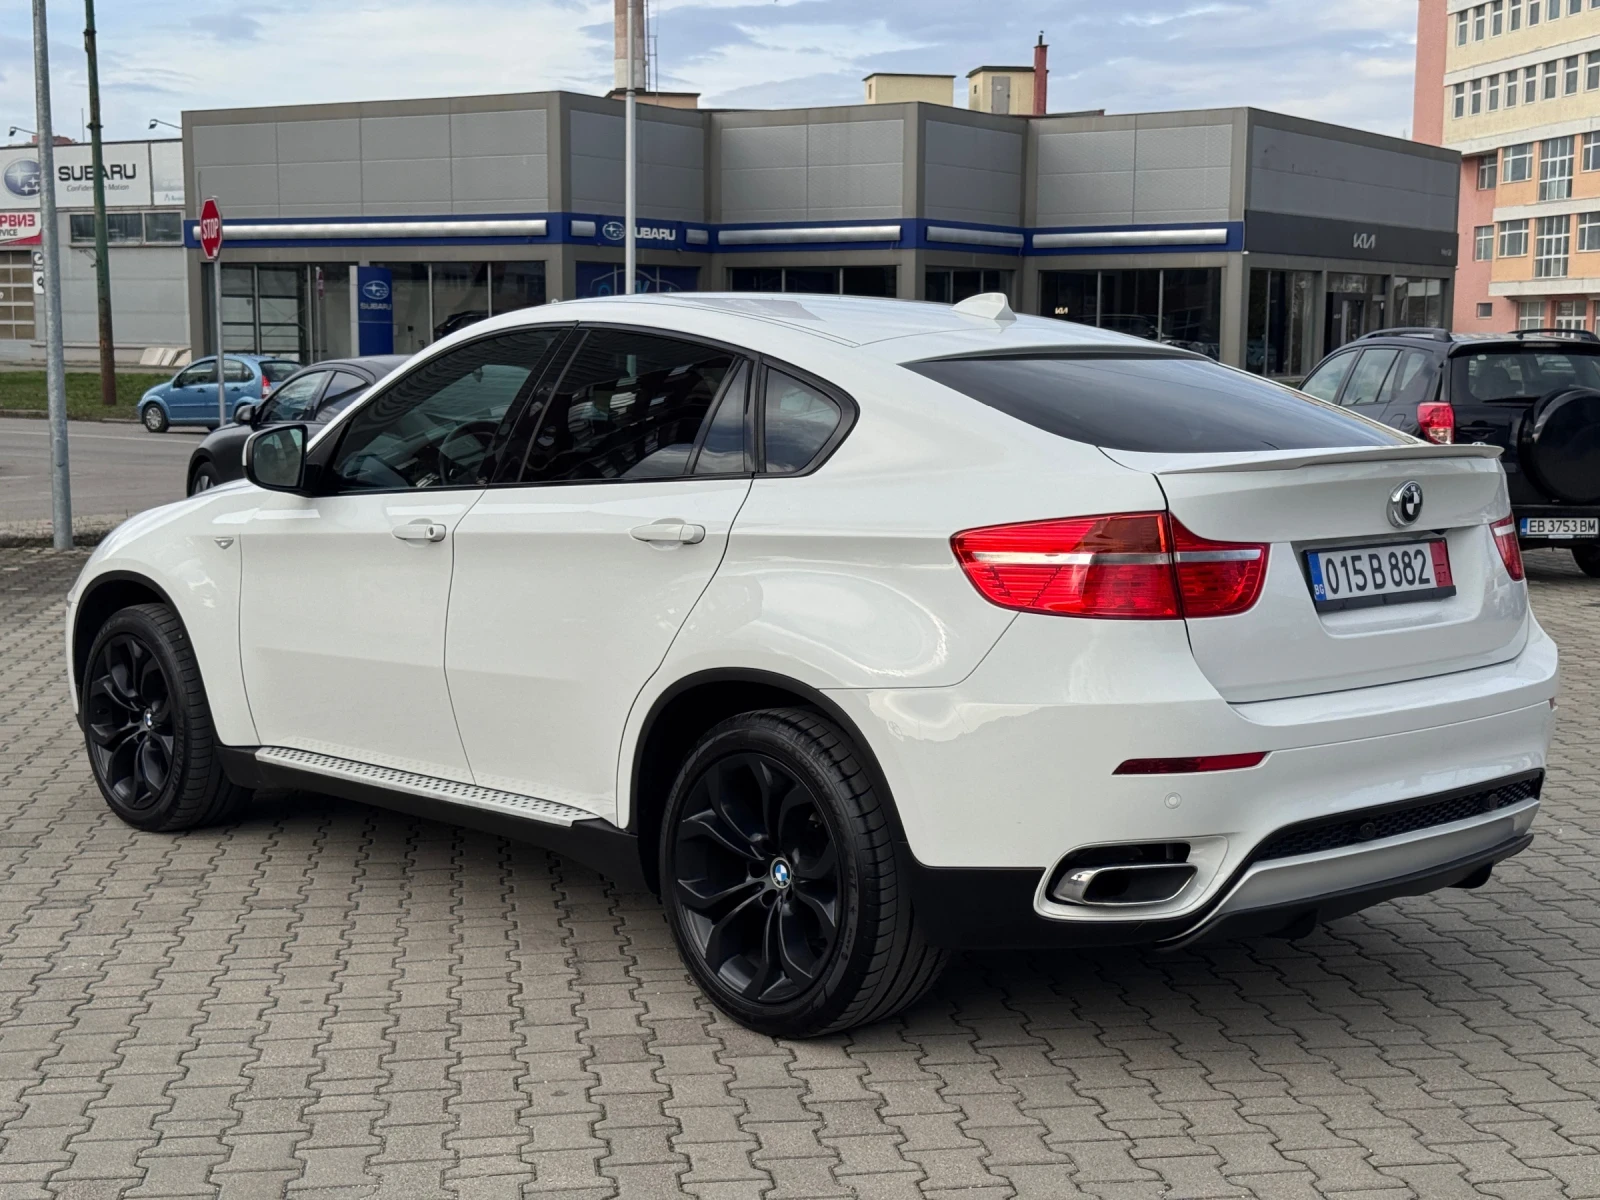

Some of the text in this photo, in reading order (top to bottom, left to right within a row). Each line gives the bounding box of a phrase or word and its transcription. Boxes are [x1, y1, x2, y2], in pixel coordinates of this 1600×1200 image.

[66, 184, 95, 192] Confiden
[202, 218, 219, 240] STOP
[635, 226, 676, 241] UBARU
[360, 302, 392, 310] SUBARU
[1529, 520, 1596, 533] EB 3753 BM
[1314, 584, 1325, 595] BG
